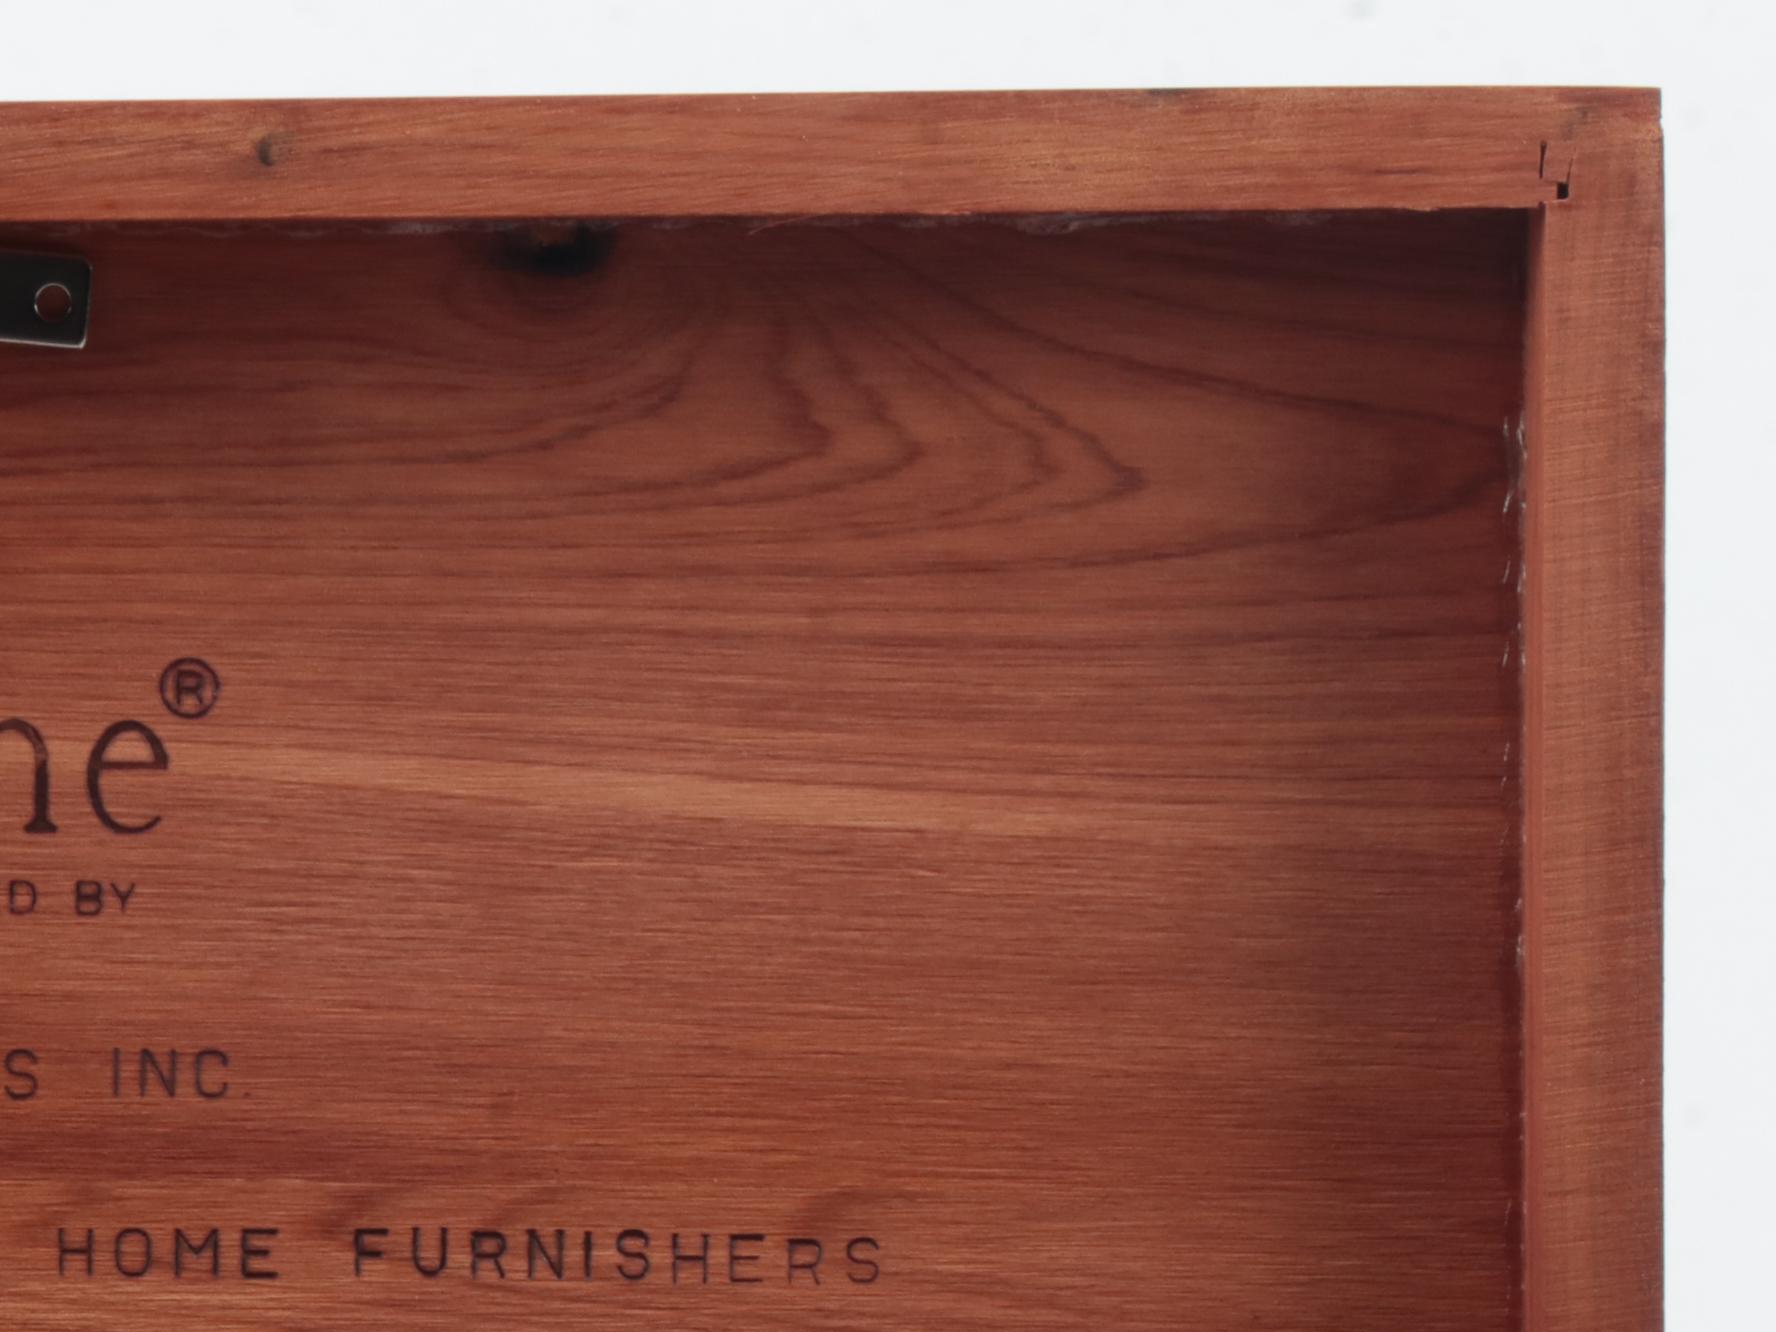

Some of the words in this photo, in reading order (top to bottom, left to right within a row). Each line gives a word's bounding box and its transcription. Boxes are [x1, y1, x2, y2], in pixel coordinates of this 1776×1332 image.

[74, 880, 136, 915] BY
[58, 1228, 280, 1279] HOME
[354, 1226, 881, 1285] FURNISHERS
